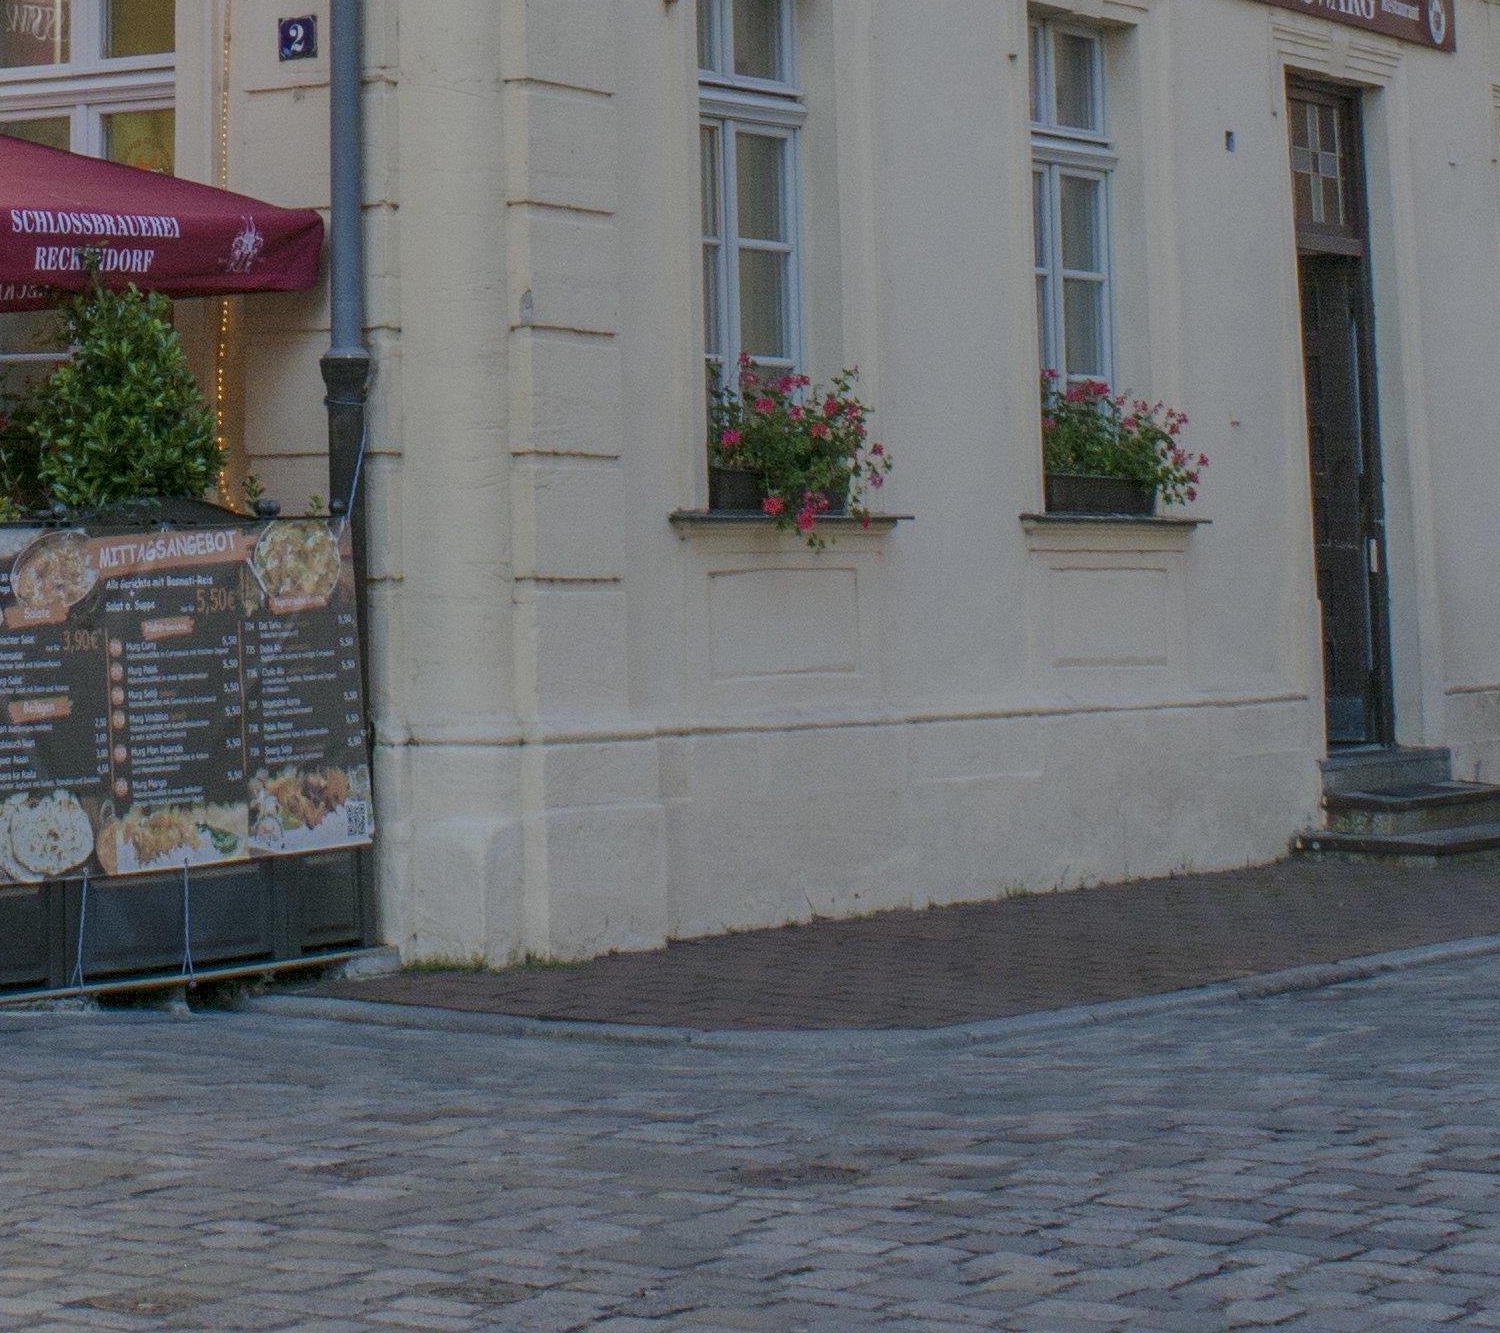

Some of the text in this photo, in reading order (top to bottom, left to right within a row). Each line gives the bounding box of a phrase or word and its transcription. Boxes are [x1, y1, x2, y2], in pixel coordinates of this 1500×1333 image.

[288, 23, 305, 53] 2
[11, 208, 181, 239] SCHLOSSBRAUEREI
[99, 530, 237, 568] MITTAGSANGEBOT
